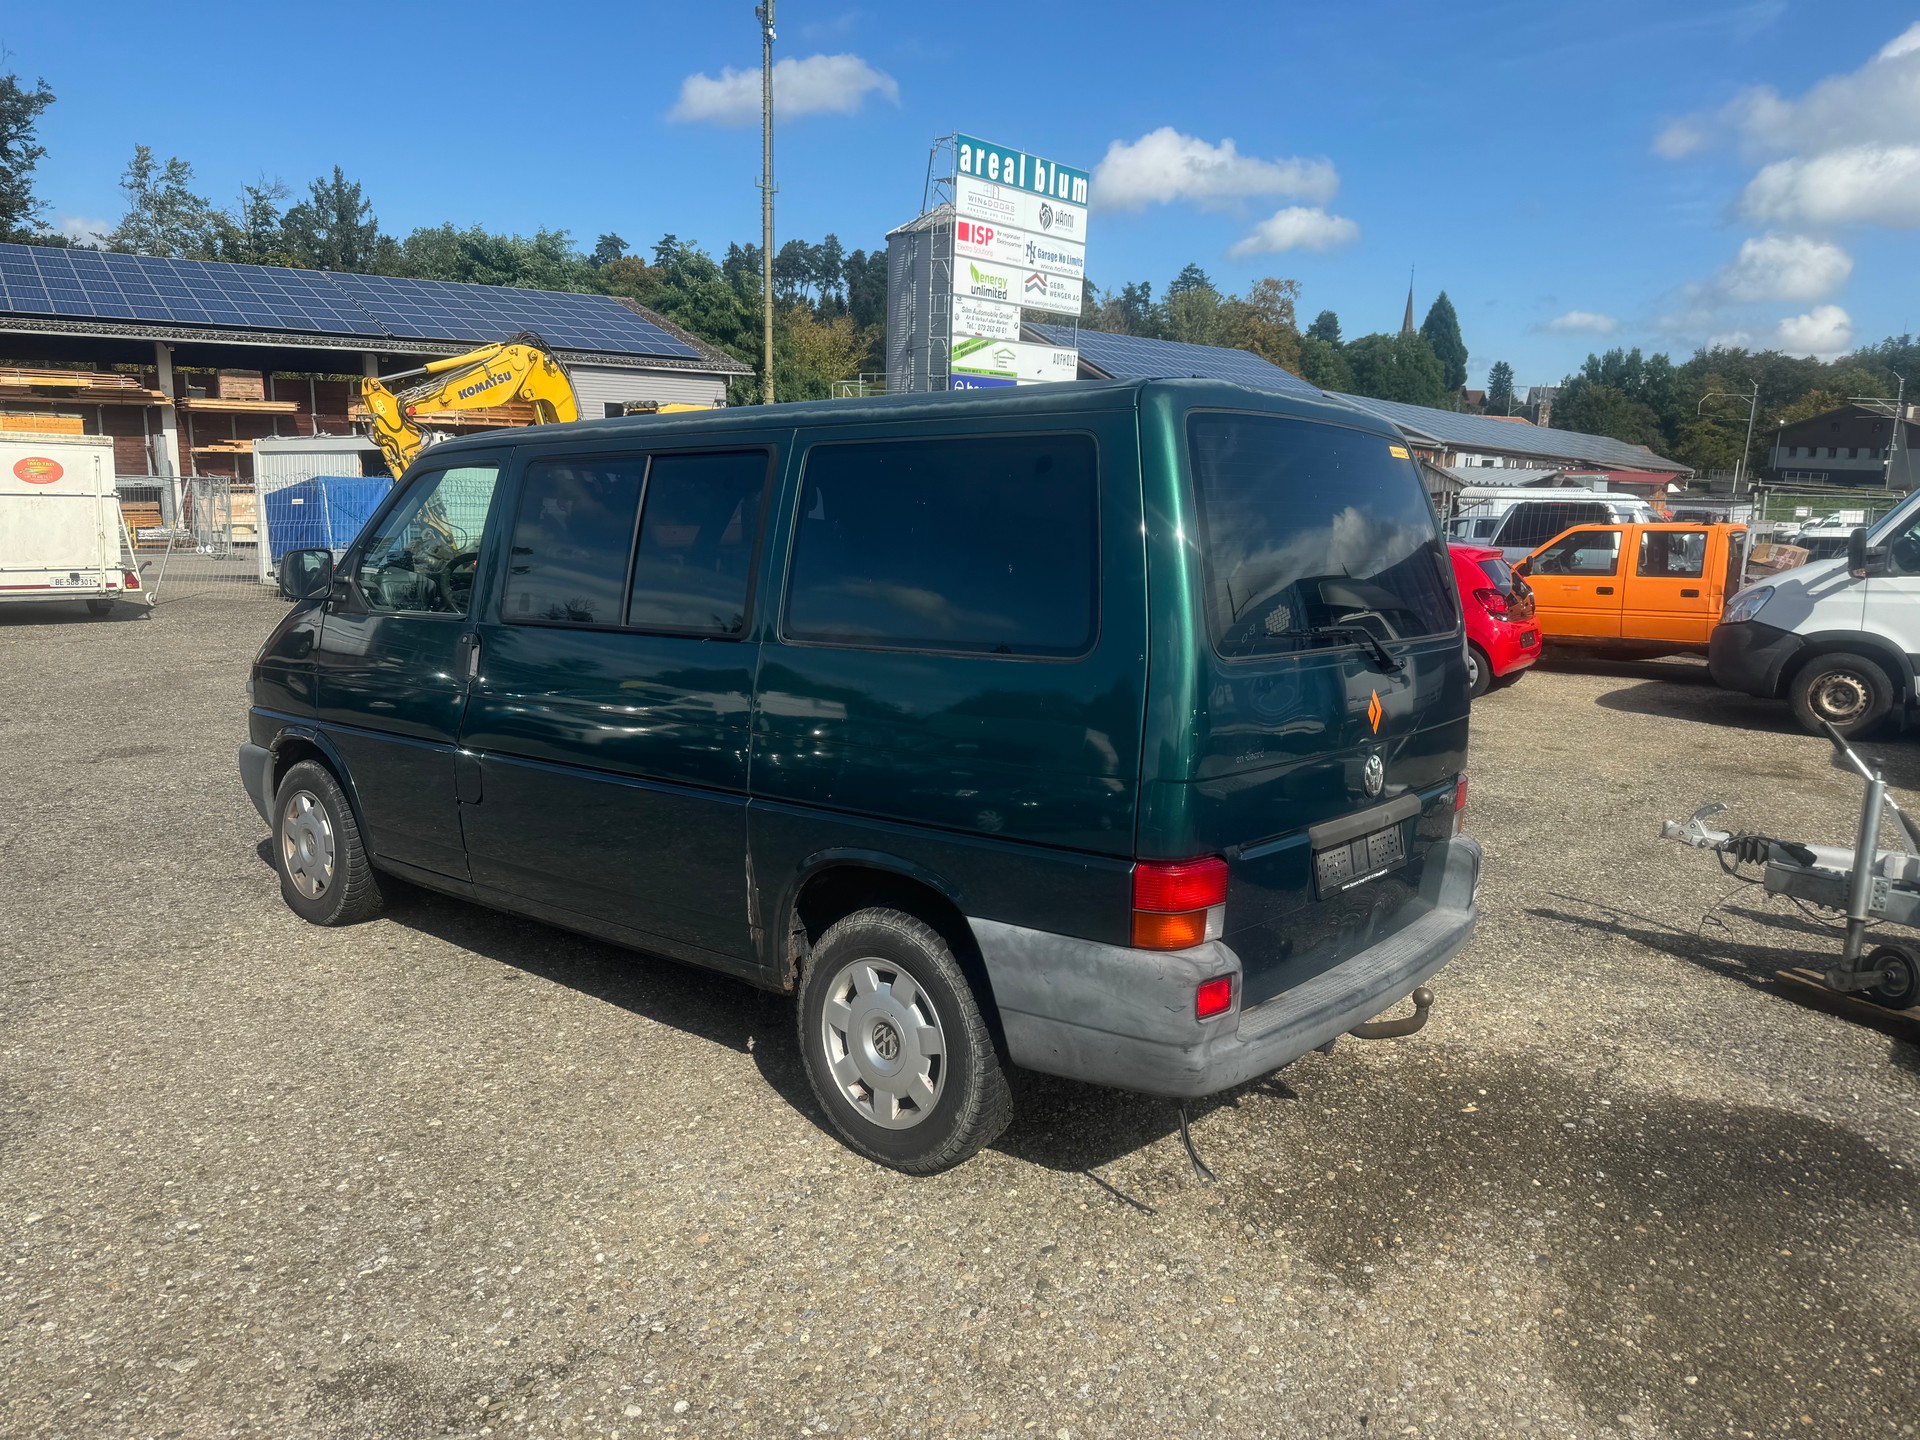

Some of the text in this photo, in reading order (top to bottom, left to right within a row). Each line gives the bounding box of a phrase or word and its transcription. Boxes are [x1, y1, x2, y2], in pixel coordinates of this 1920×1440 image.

[960, 144, 1088, 204] areal blum
[971, 224, 994, 246] ISP
[1037, 248, 1058, 263] Garage
[980, 273, 1008, 289] energy
[971, 284, 1008, 300] unlimited
[1049, 290, 1072, 301] WENGER
[458, 370, 512, 400] KOMATSU
[55, 578, 64, 586] BE
